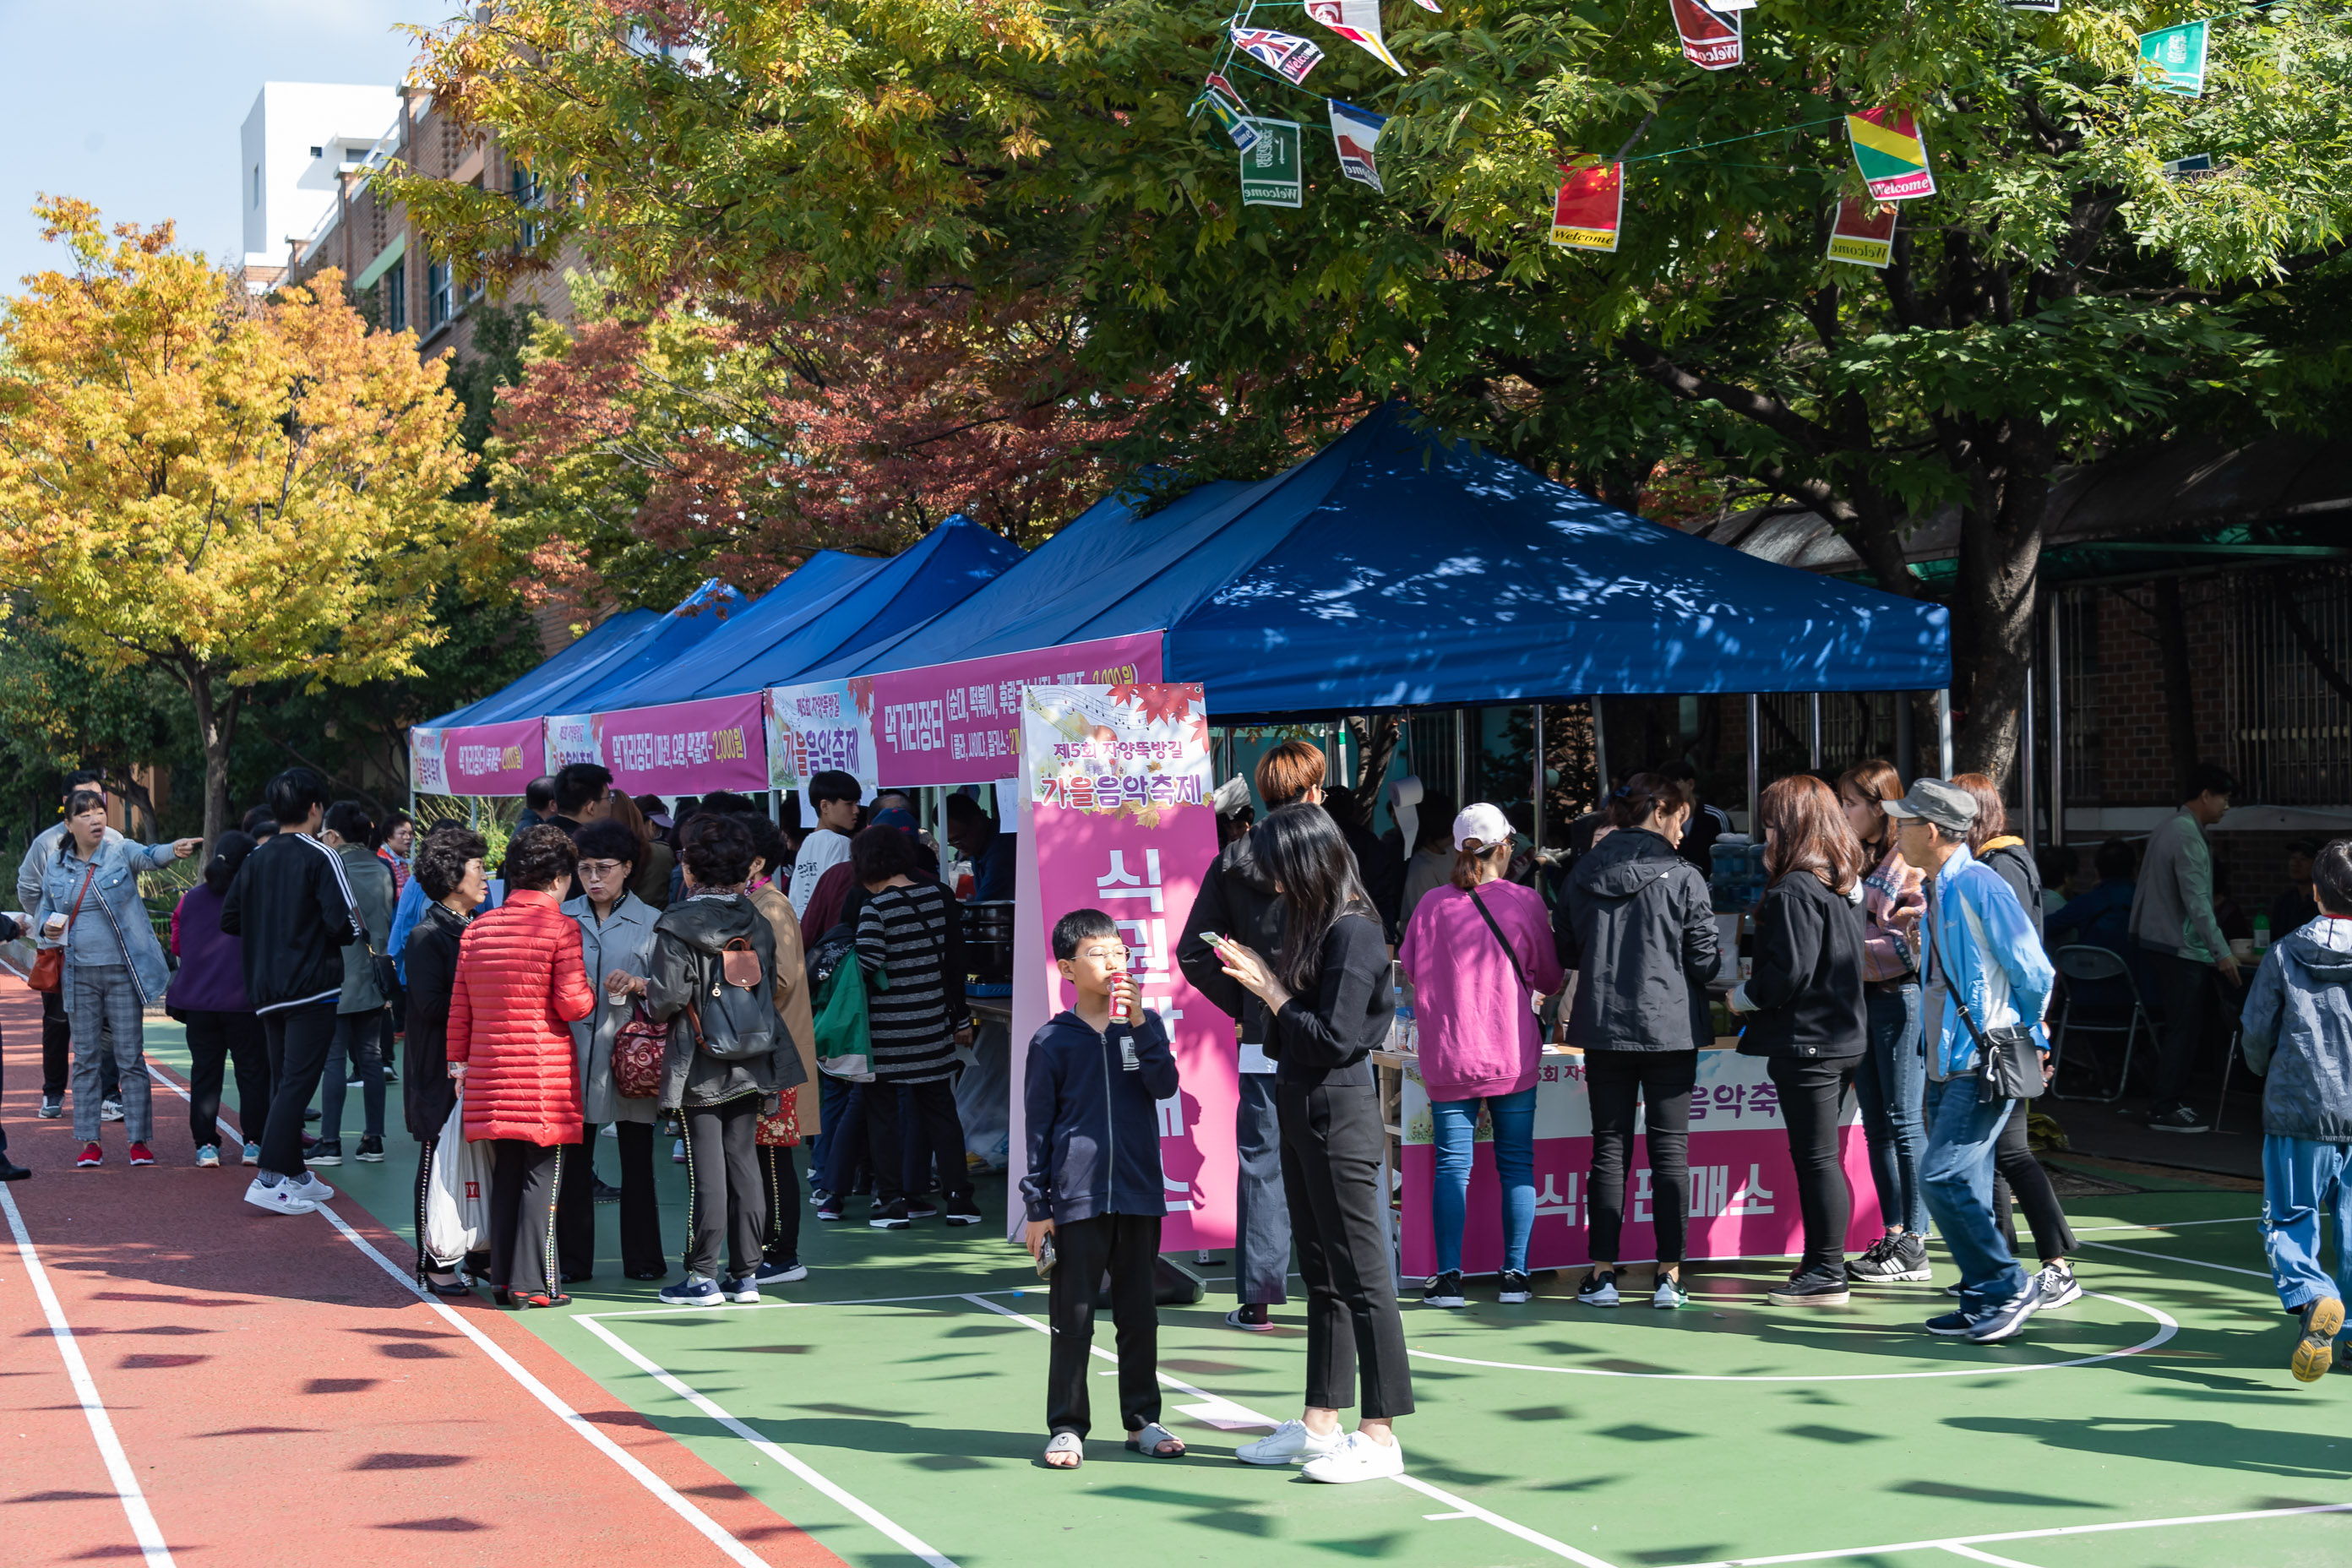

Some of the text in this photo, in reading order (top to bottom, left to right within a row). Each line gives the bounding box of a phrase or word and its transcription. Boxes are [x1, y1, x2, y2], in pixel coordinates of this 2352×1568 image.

[1282, 44, 1319, 77] Welcome
[1870, 178, 1929, 196] Welcome
[1554, 230, 1614, 245] Welcome
[884, 699, 945, 754] 먹거리장터
[783, 727, 860, 777] 가을음악축제
[1054, 740, 1184, 760] 제5회 자양뚝방길
[1040, 773, 1203, 808] 가을음악축제
